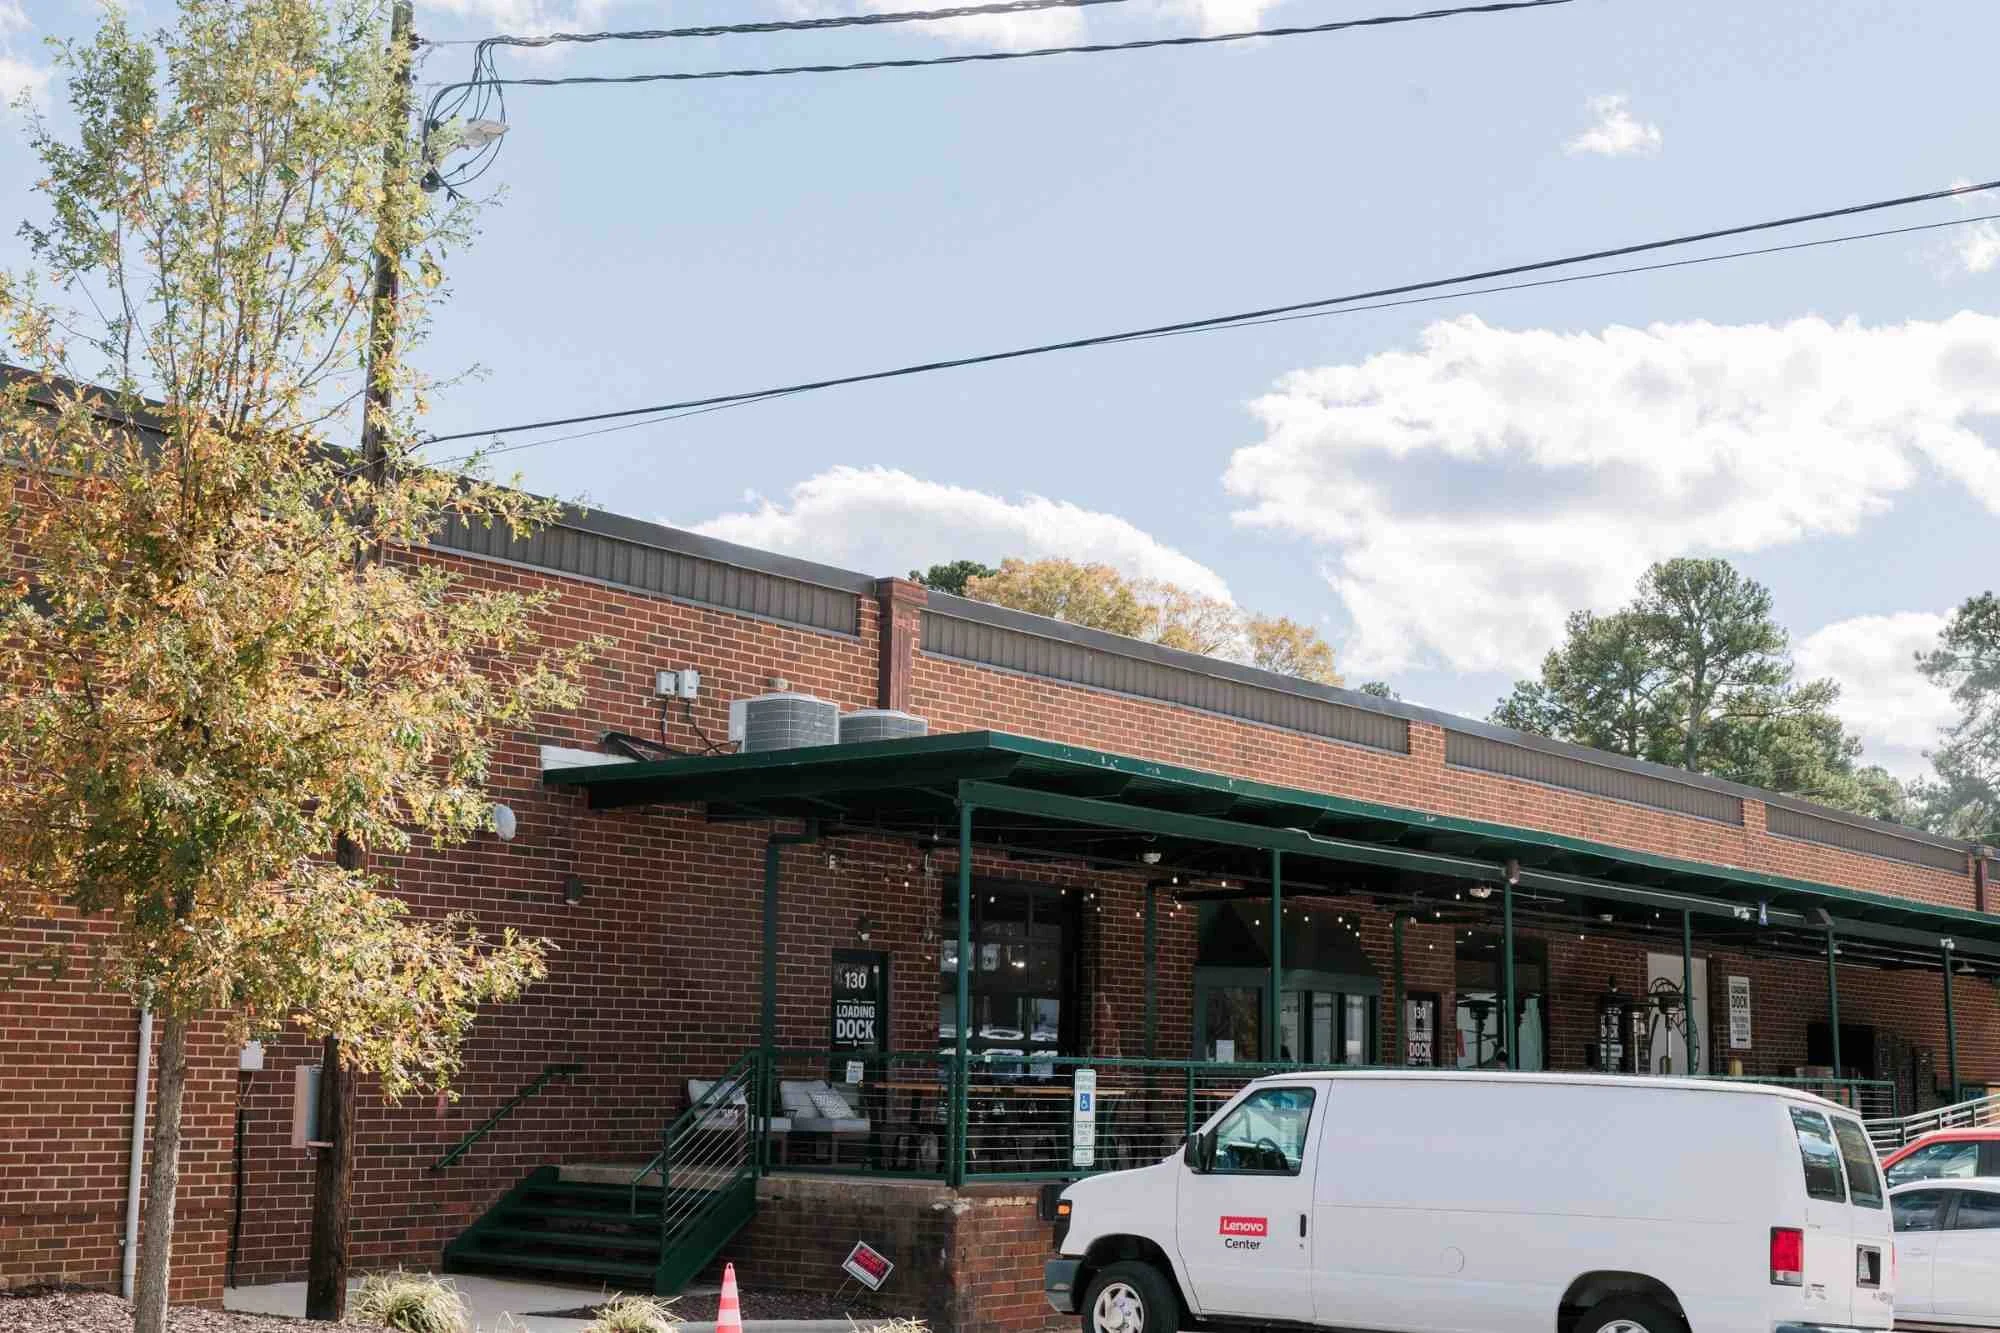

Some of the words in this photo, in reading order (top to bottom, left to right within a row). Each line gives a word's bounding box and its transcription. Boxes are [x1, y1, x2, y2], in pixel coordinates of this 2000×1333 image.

[844, 972, 867, 989] 130
[836, 1005, 876, 1018] LOADING
[835, 1019, 875, 1039] DOCK
[1409, 1042, 1432, 1057] DOCK
[1223, 1219, 1264, 1232] Lenovo
[1224, 1238, 1261, 1250] Center
